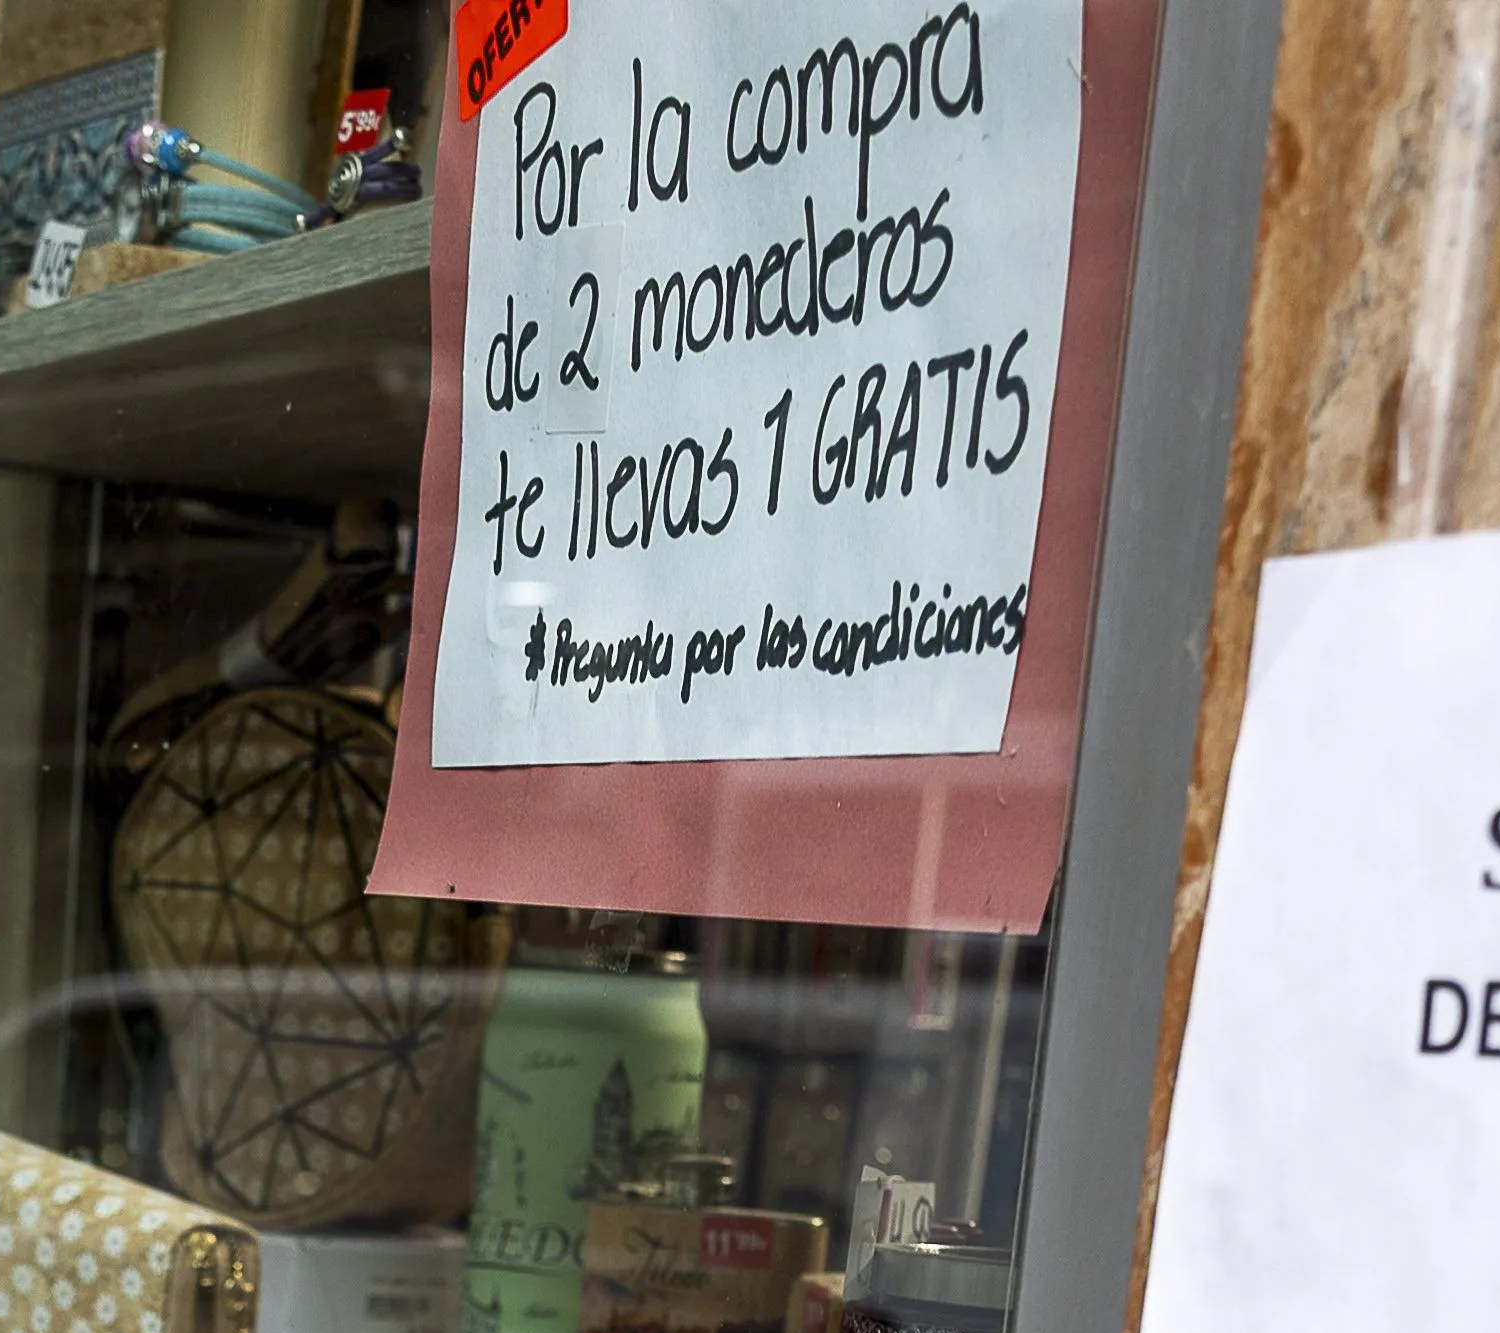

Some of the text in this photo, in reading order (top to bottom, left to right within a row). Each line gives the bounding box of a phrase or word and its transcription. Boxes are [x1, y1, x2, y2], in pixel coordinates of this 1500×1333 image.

[467, 0, 543, 104] OFER
[513, 1, 982, 240] Por la compra
[486, 188, 954, 412] de 2 monederos
[485, 329, 1030, 575] te llevas 1 GRATIS
[682, 624, 746, 703] por
[756, 604, 806, 671] las
[812, 580, 1027, 677] condiciones
